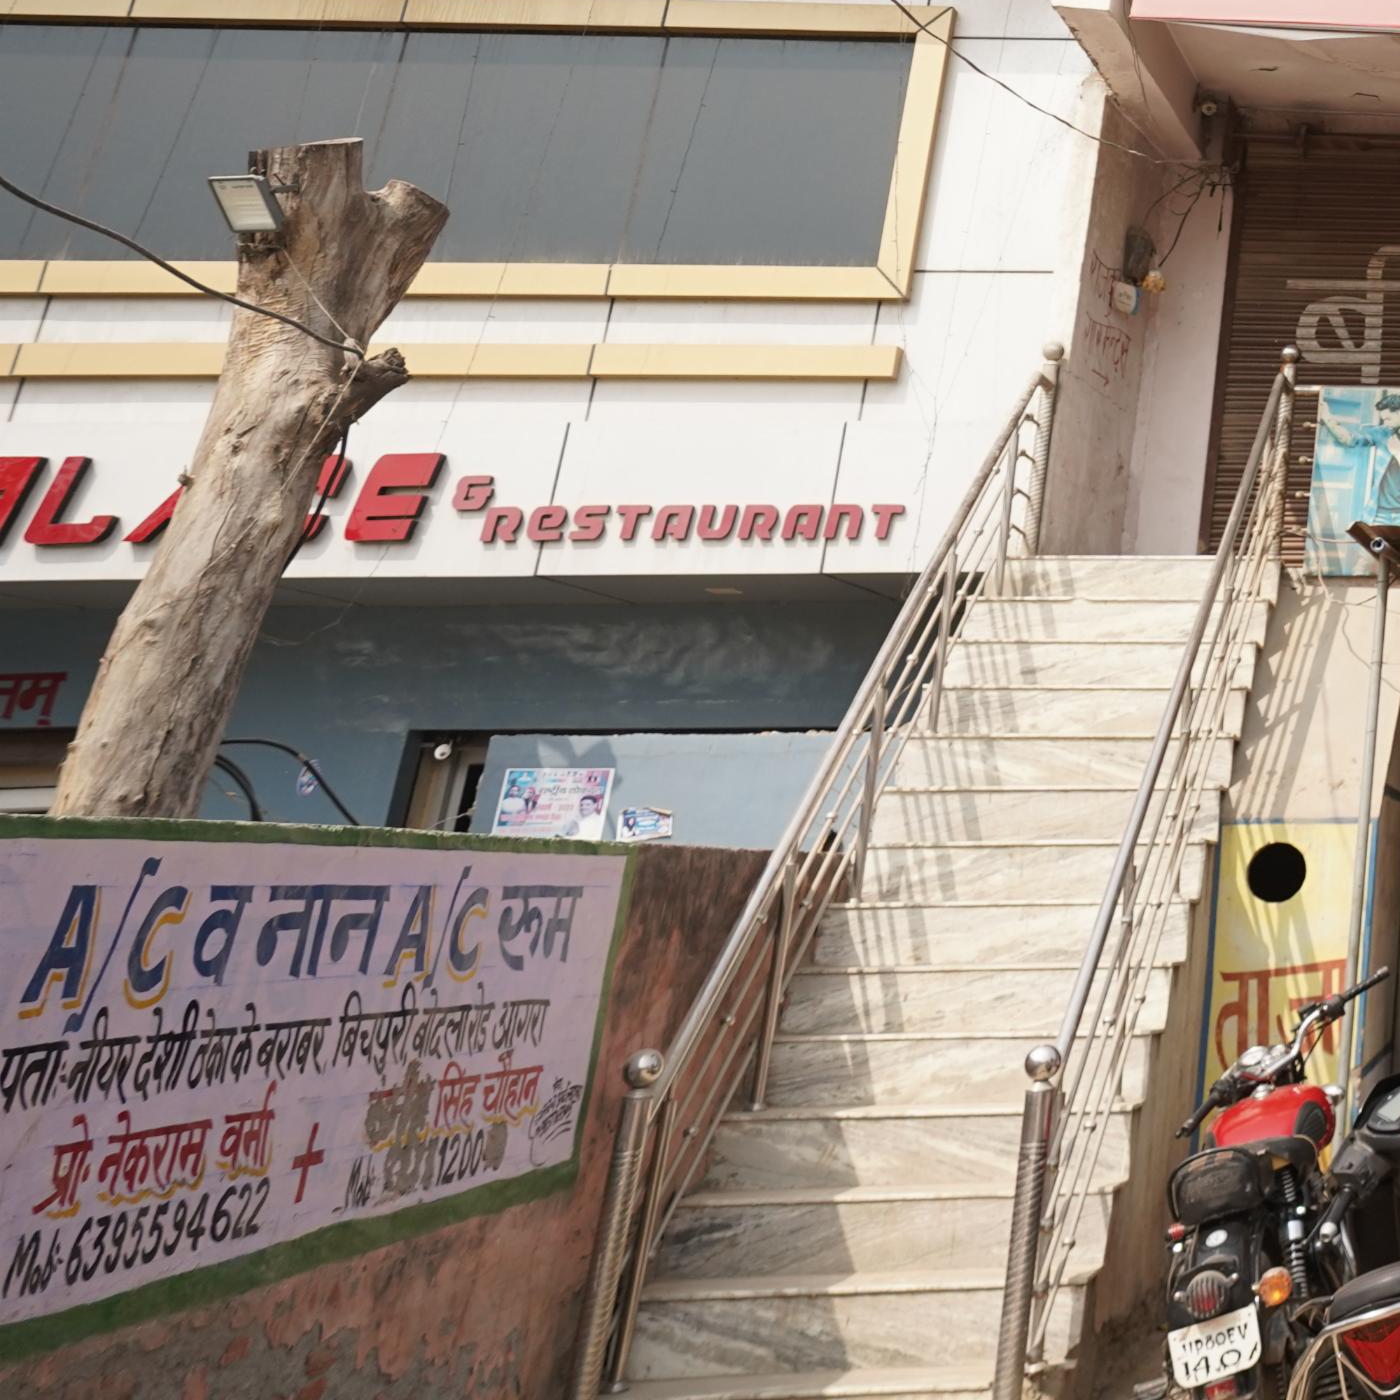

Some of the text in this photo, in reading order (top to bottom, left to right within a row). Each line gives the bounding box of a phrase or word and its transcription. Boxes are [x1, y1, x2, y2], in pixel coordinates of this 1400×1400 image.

[18, 856, 192, 1036] A/C
[192, 885, 253, 986] व
[256, 884, 390, 978] नान
[382, 865, 490, 992] A/C
[220, 1080, 278, 1170] वर्मा
